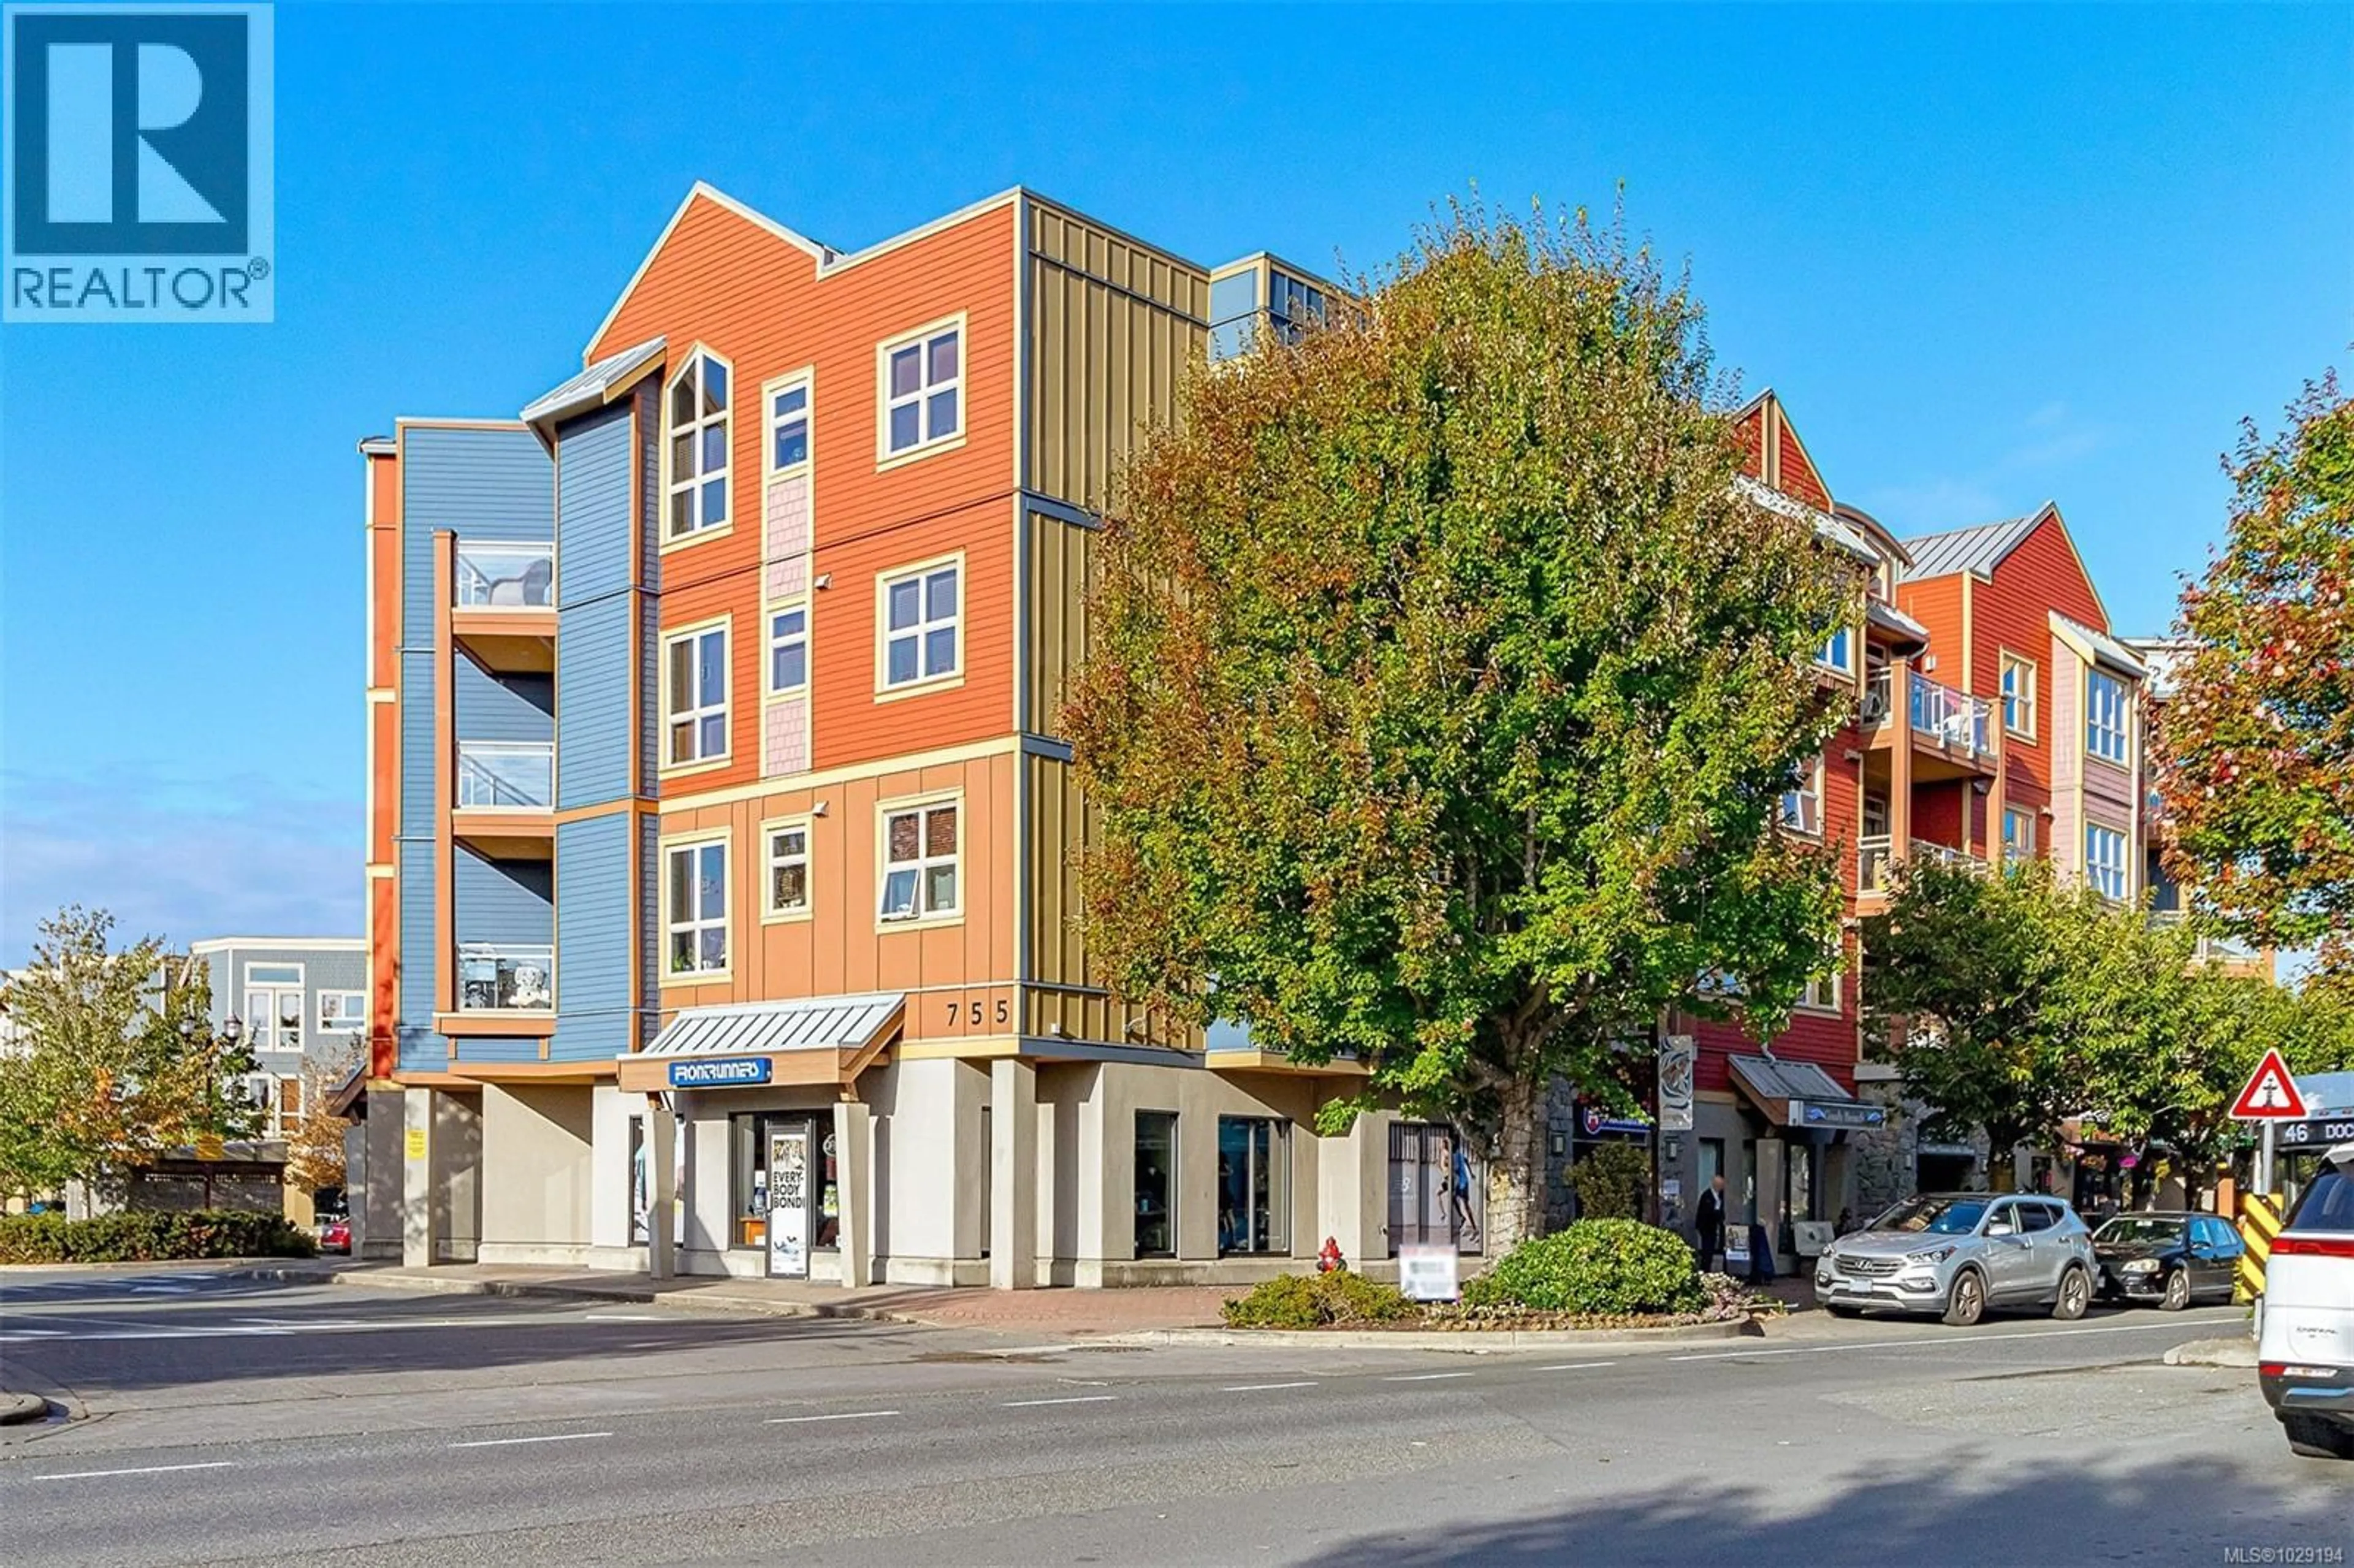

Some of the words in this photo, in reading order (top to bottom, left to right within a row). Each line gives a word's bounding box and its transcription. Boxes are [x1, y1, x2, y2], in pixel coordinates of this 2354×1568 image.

[2285, 1124, 2308, 1142] 46
[774, 1171, 804, 1183] EVERY-
[774, 1184, 800, 1196] BODY
